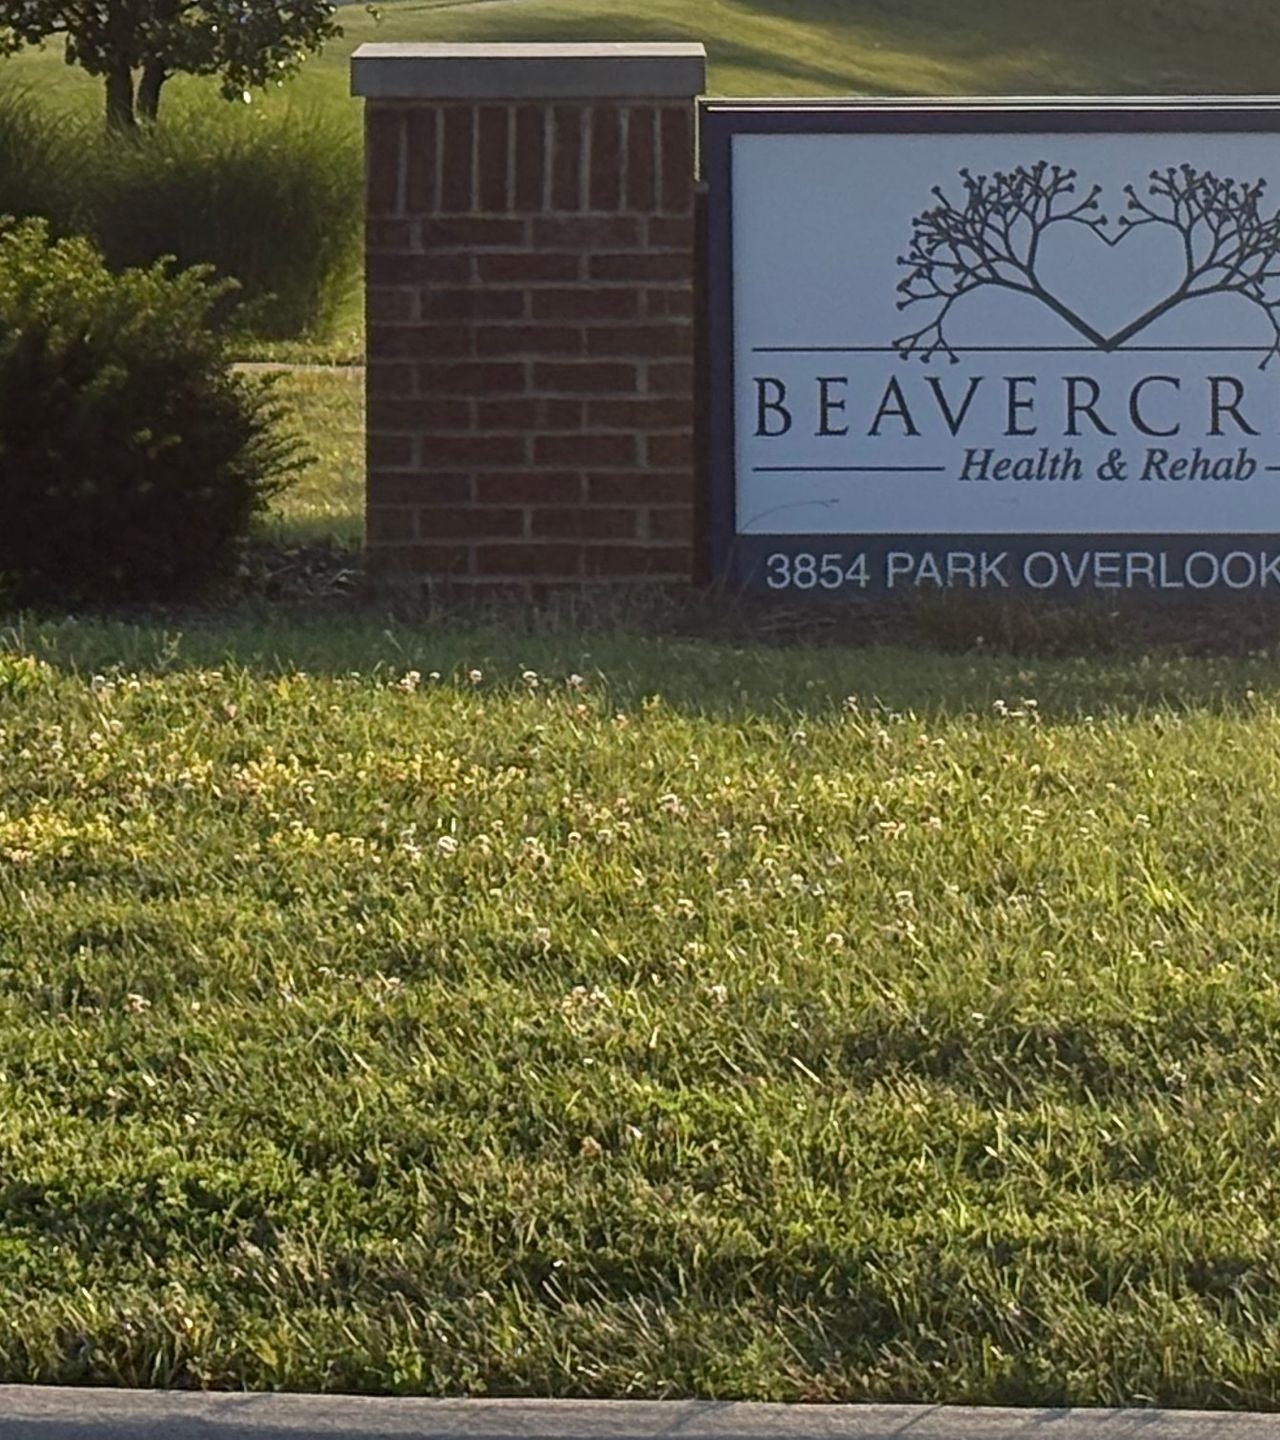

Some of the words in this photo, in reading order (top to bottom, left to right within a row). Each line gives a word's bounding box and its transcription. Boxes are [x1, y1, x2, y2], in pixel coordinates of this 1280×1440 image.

[957, 447, 1083, 482] Health
[1096, 447, 1128, 482] &
[1139, 447, 1257, 482] Rehab
[766, 552, 871, 589] 3854
[887, 551, 1009, 589] PARK
